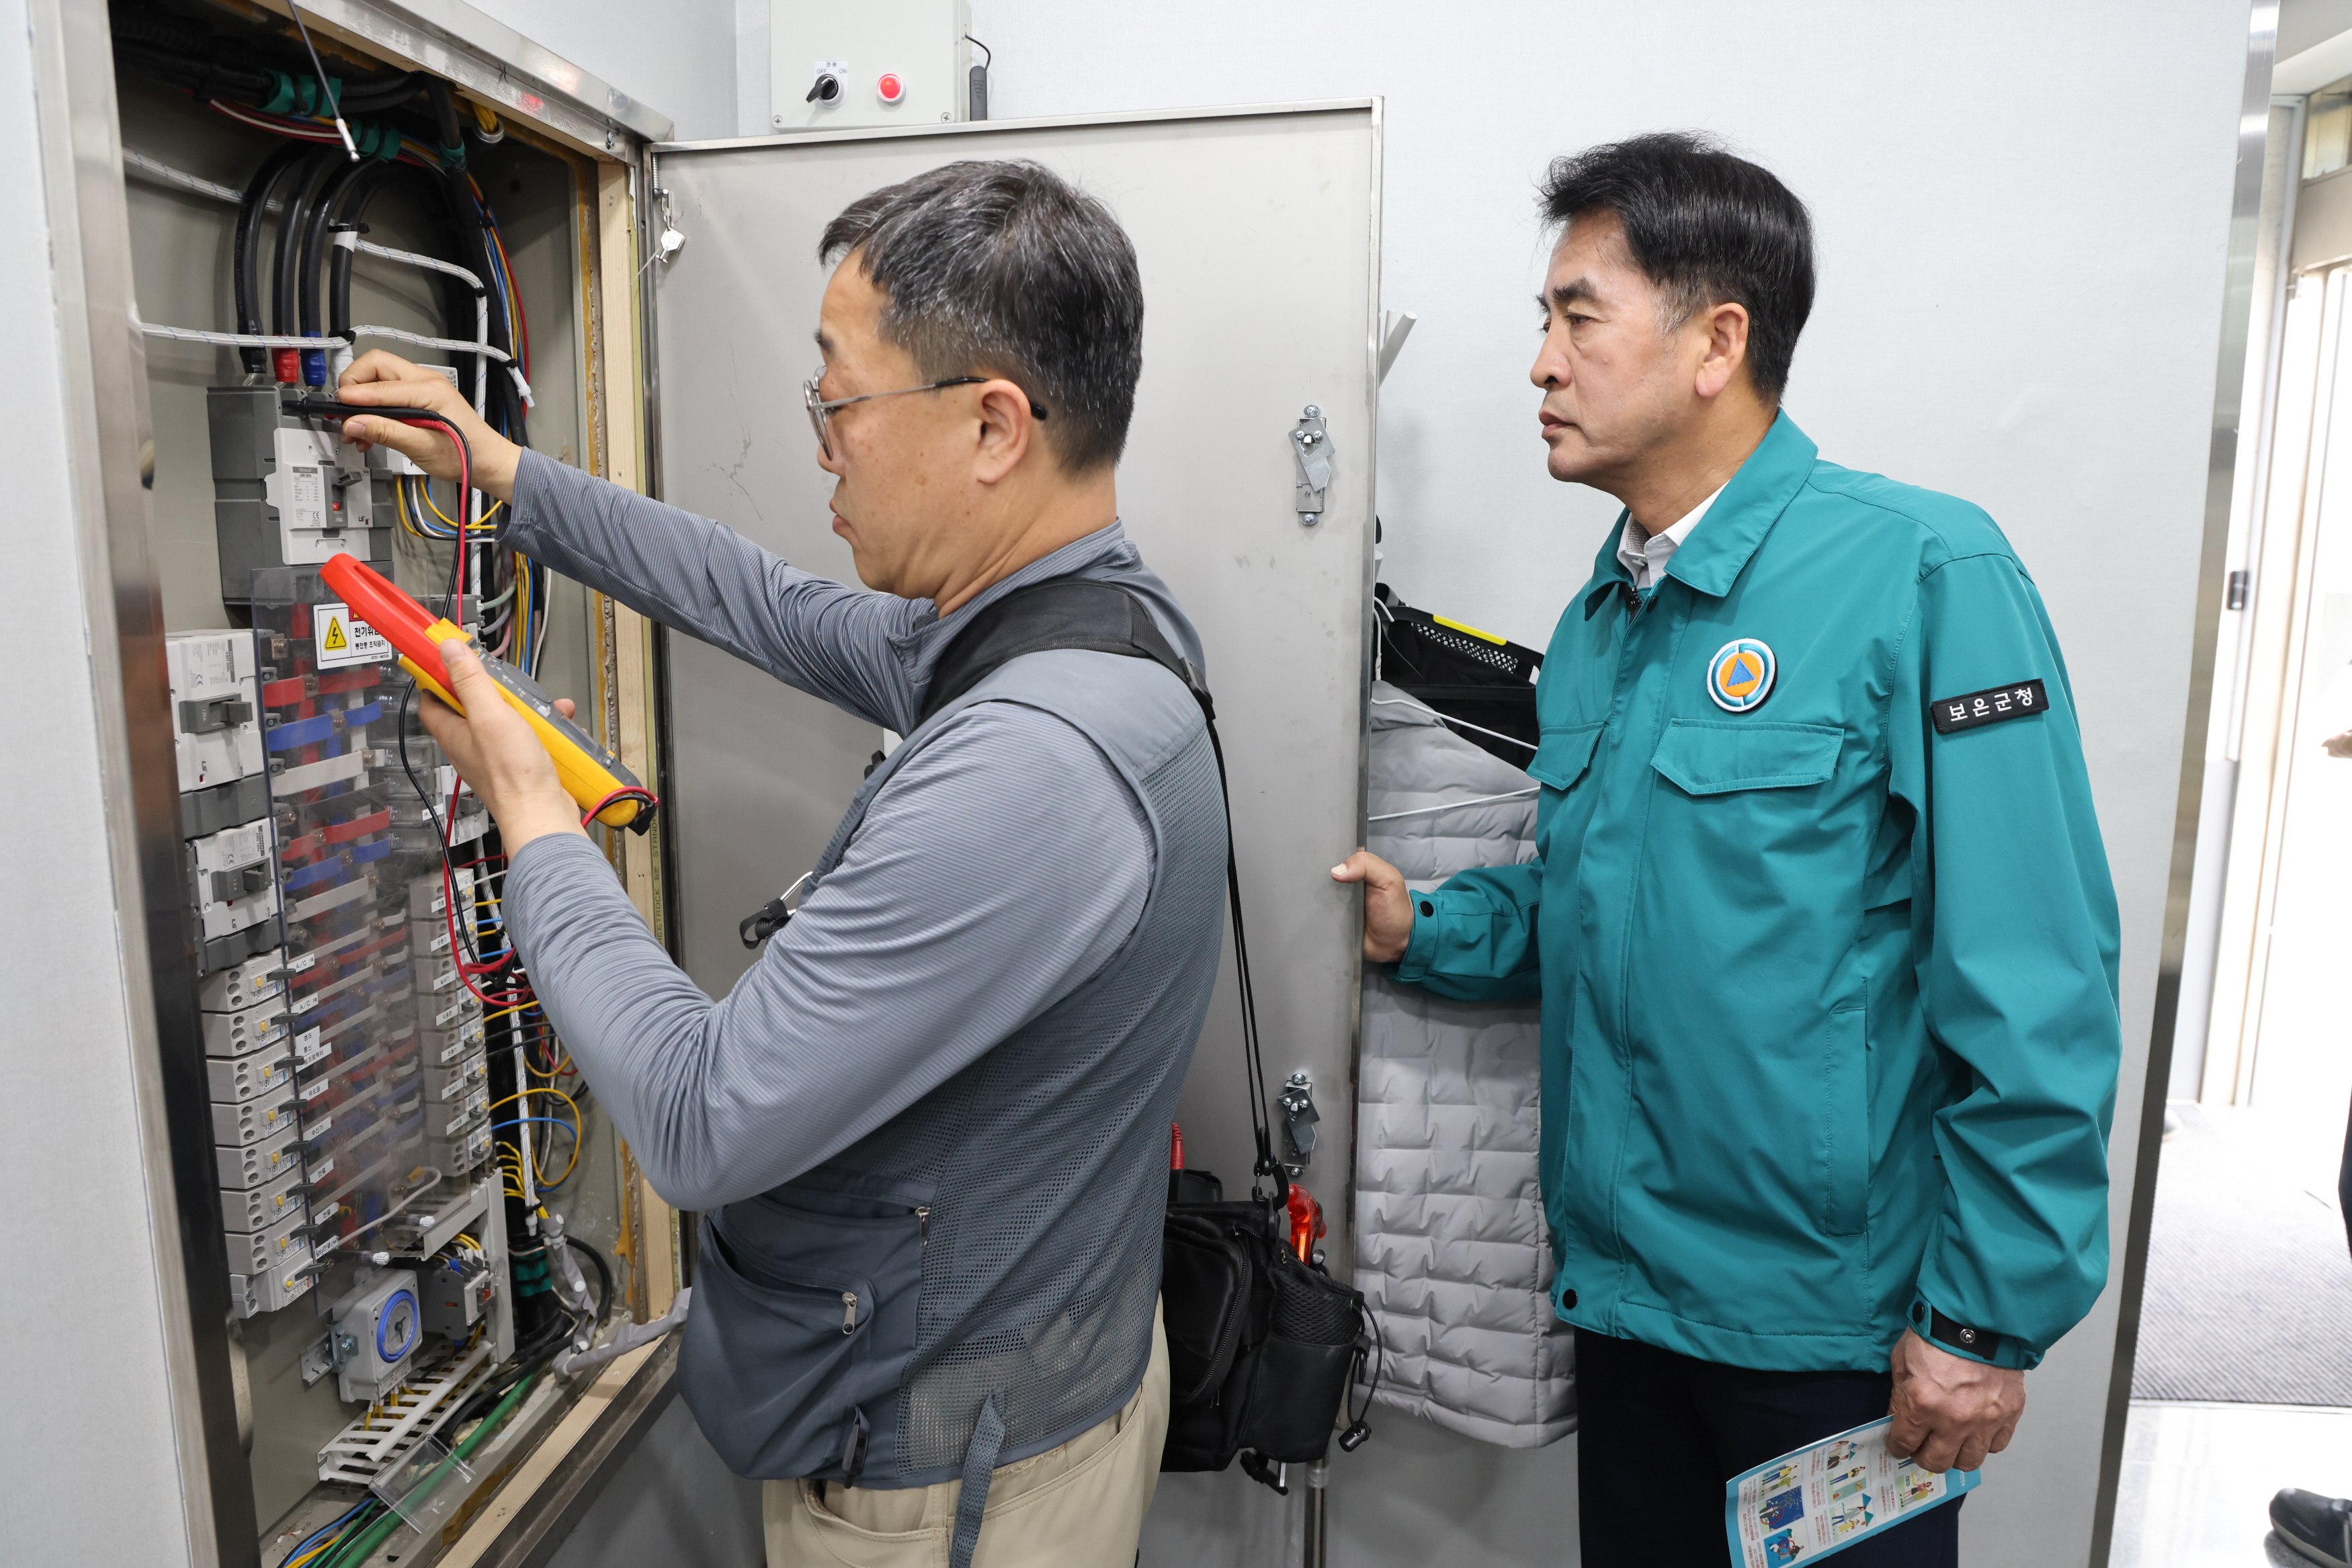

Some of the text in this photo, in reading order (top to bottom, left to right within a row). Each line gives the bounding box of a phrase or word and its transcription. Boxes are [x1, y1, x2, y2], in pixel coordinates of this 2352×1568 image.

[354, 625, 380, 638] 전기위
[369, 640, 385, 648] 조작금지
[1949, 687, 2034, 722] 보은군청
[296, 960, 307, 969] A/C
[300, 1000, 310, 1010] A/C
